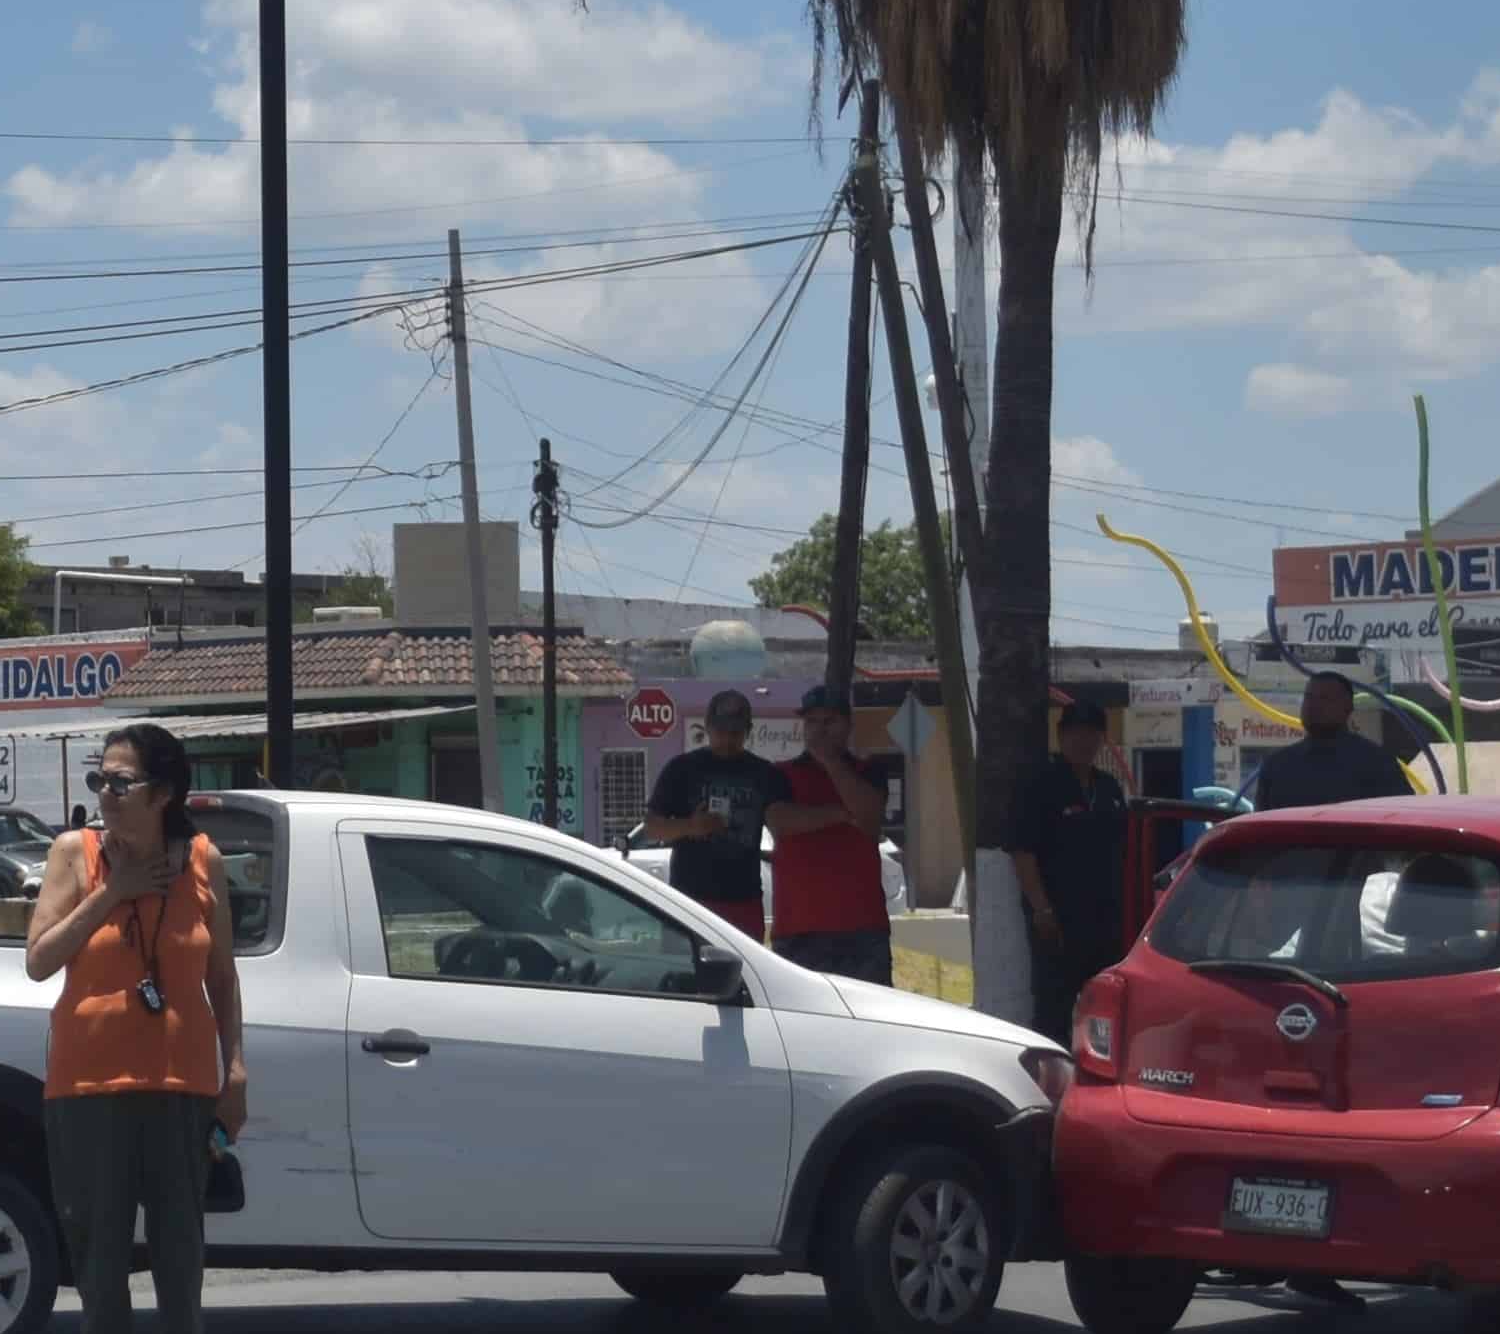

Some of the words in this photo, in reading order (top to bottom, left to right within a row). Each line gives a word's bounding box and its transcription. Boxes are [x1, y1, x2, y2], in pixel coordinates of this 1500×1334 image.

[1303, 608, 1354, 641] Todo
[1361, 617, 1413, 647] para
[1418, 608, 1440, 637] el
[630, 704, 673, 724] ALTO
[526, 766, 575, 782] TAOS
[1139, 1066, 1195, 1084] MARCH
